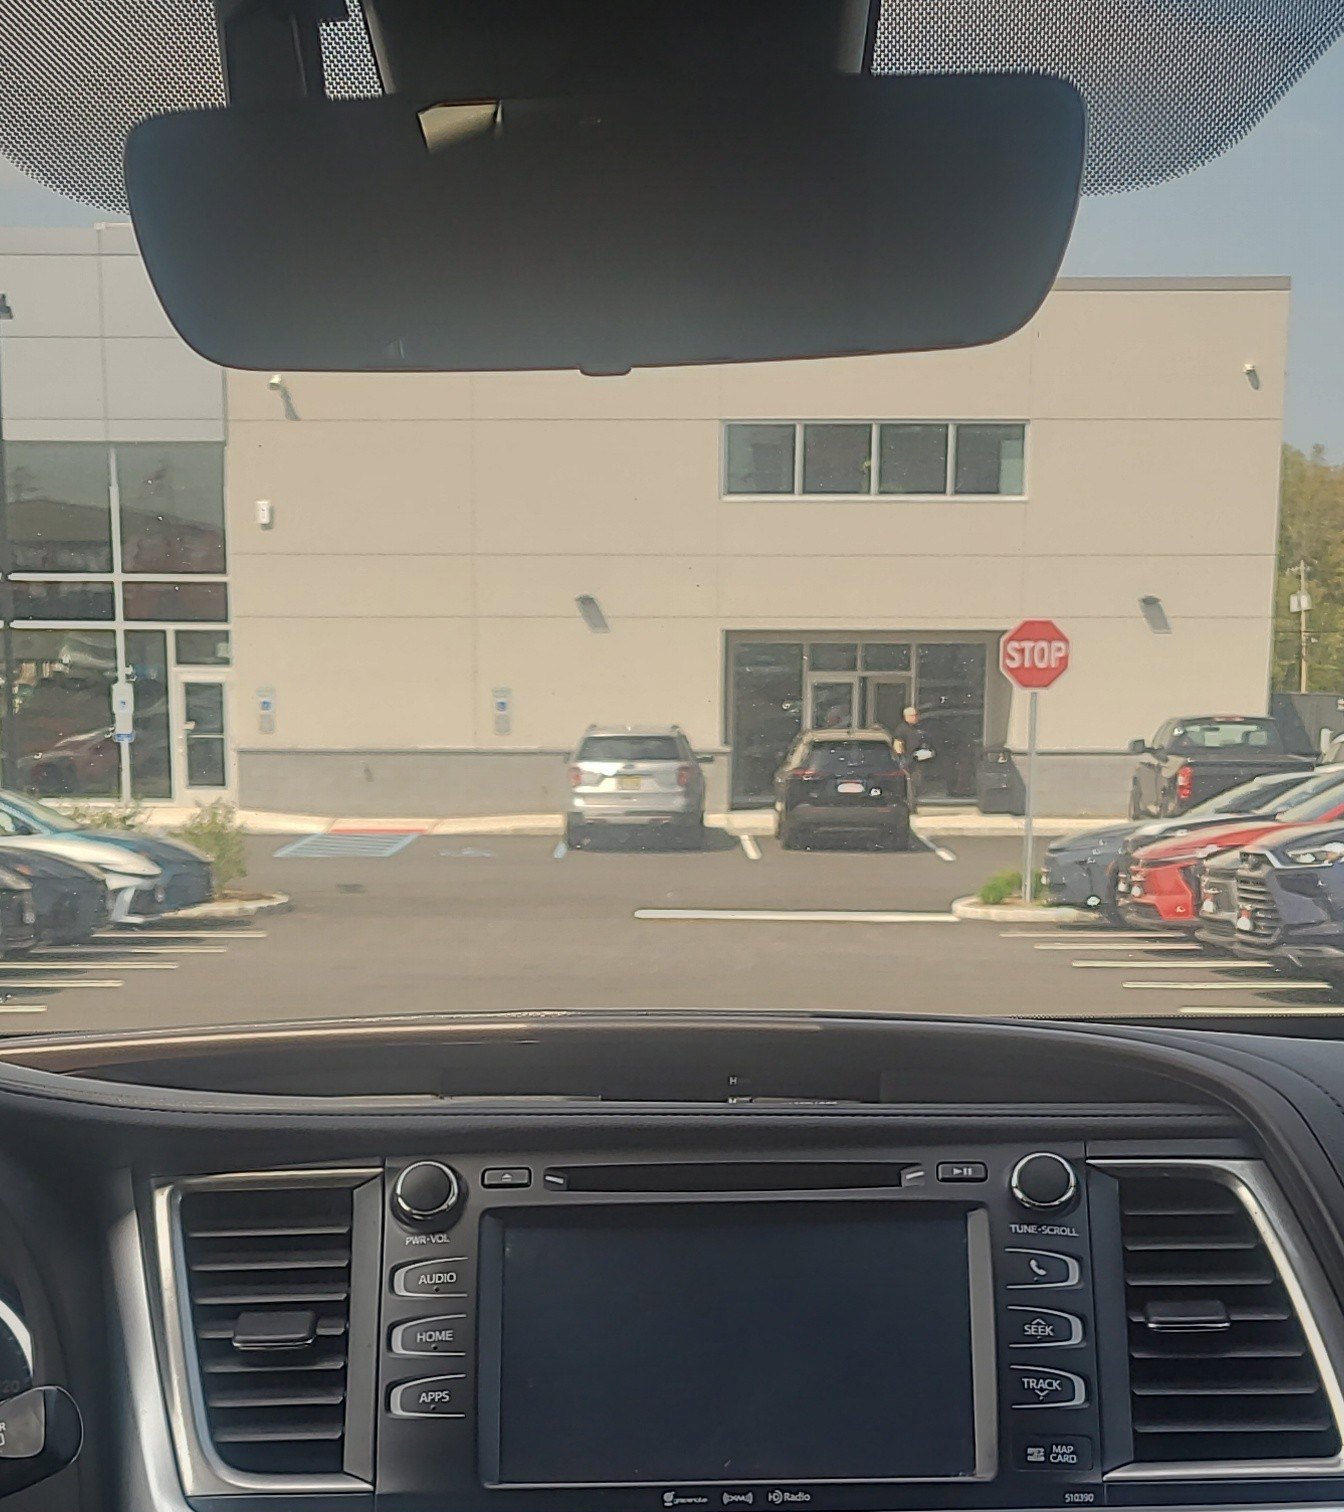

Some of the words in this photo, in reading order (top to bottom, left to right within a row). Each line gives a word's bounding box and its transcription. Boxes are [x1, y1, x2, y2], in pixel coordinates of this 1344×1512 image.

[1005, 640, 1066, 669] STOP
[418, 1271, 457, 1285] AUDIO
[416, 1330, 454, 1343] HOME
[1024, 1324, 1054, 1337] SEEK
[1022, 1377, 1062, 1391] TRACK
[419, 1390, 450, 1404] APPS
[1052, 1444, 1074, 1454] MAP
[1049, 1453, 1077, 1464] CARD
[784, 1491, 811, 1502] Radio
